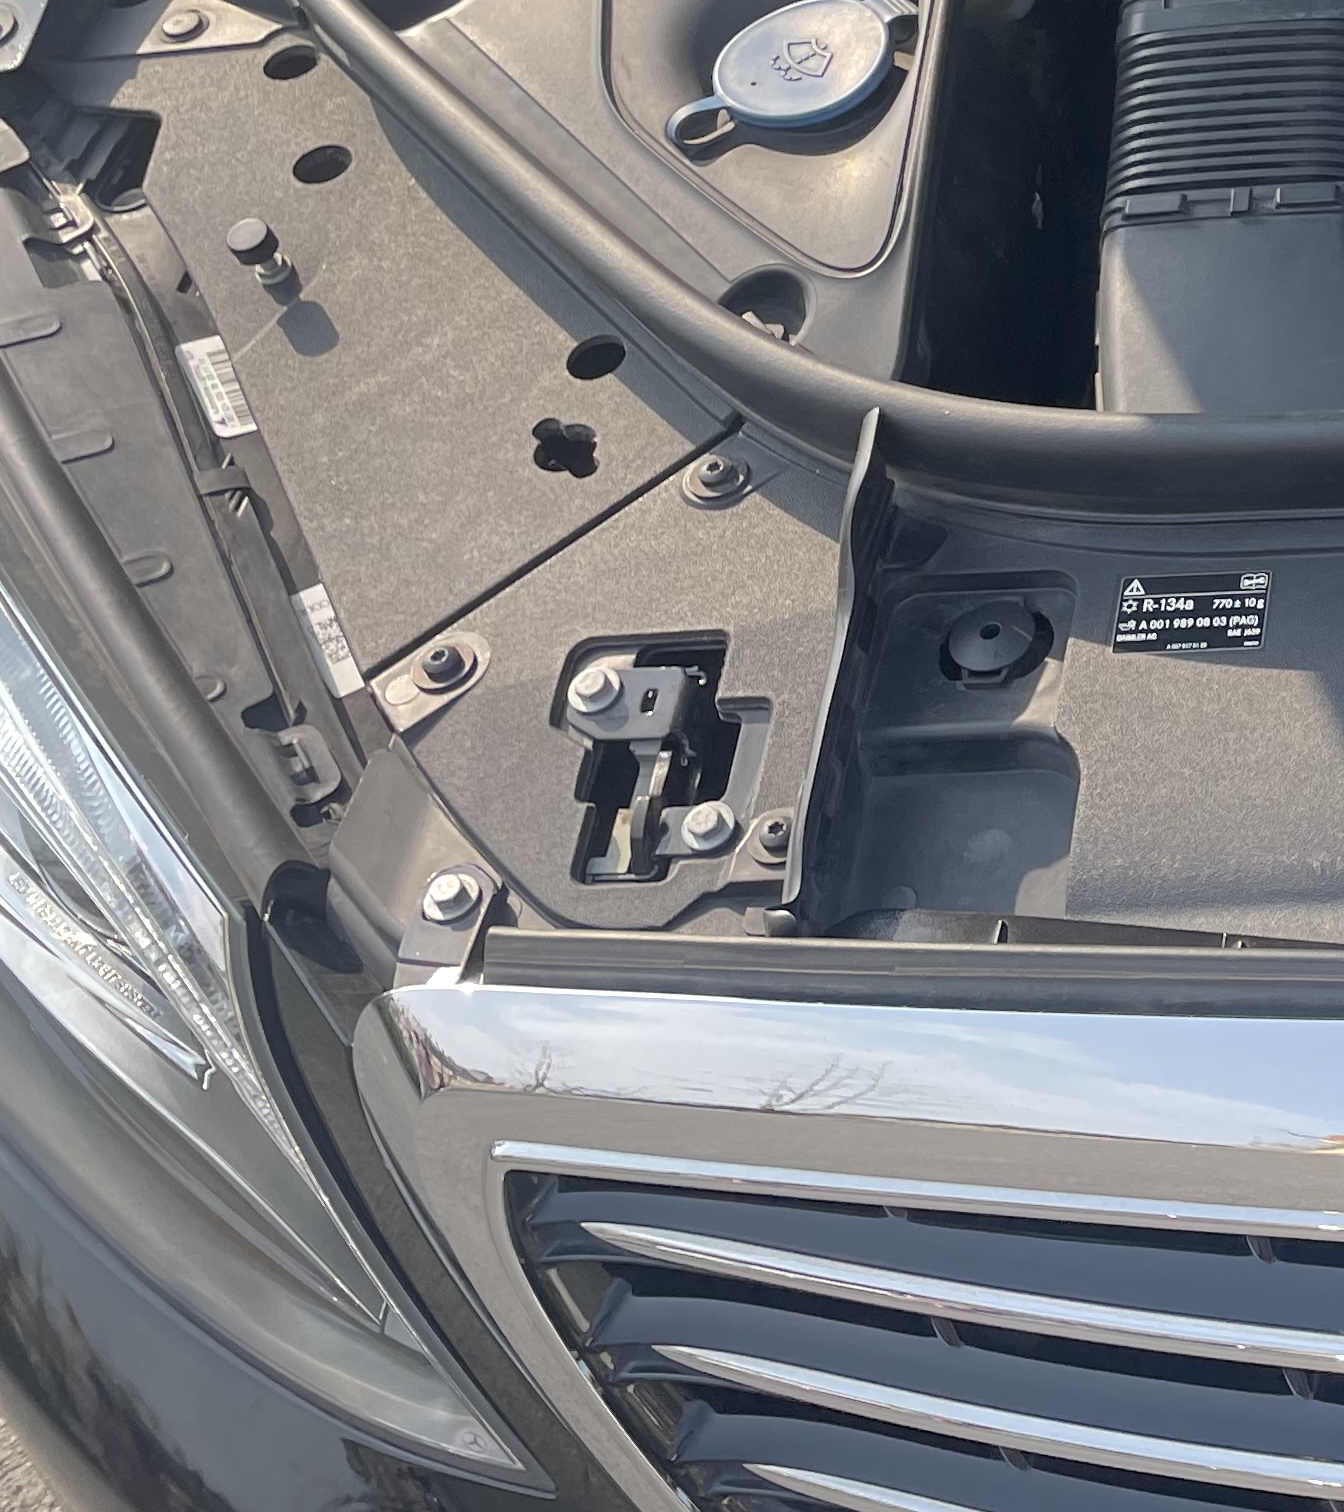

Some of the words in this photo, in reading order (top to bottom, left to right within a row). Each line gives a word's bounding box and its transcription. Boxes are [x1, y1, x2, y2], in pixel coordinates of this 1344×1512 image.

[1142, 598, 1194, 612] R-134a
[1212, 598, 1233, 609] 770
[1245, 597, 1256, 607] 10
[1256, 598, 1265, 609] g
[1138, 620, 1148, 630] A
[1149, 619, 1170, 630] 001
[1173, 617, 1195, 629] 989
[1213, 616, 1227, 627] 03
[1229, 615, 1259, 628] (PAG)
